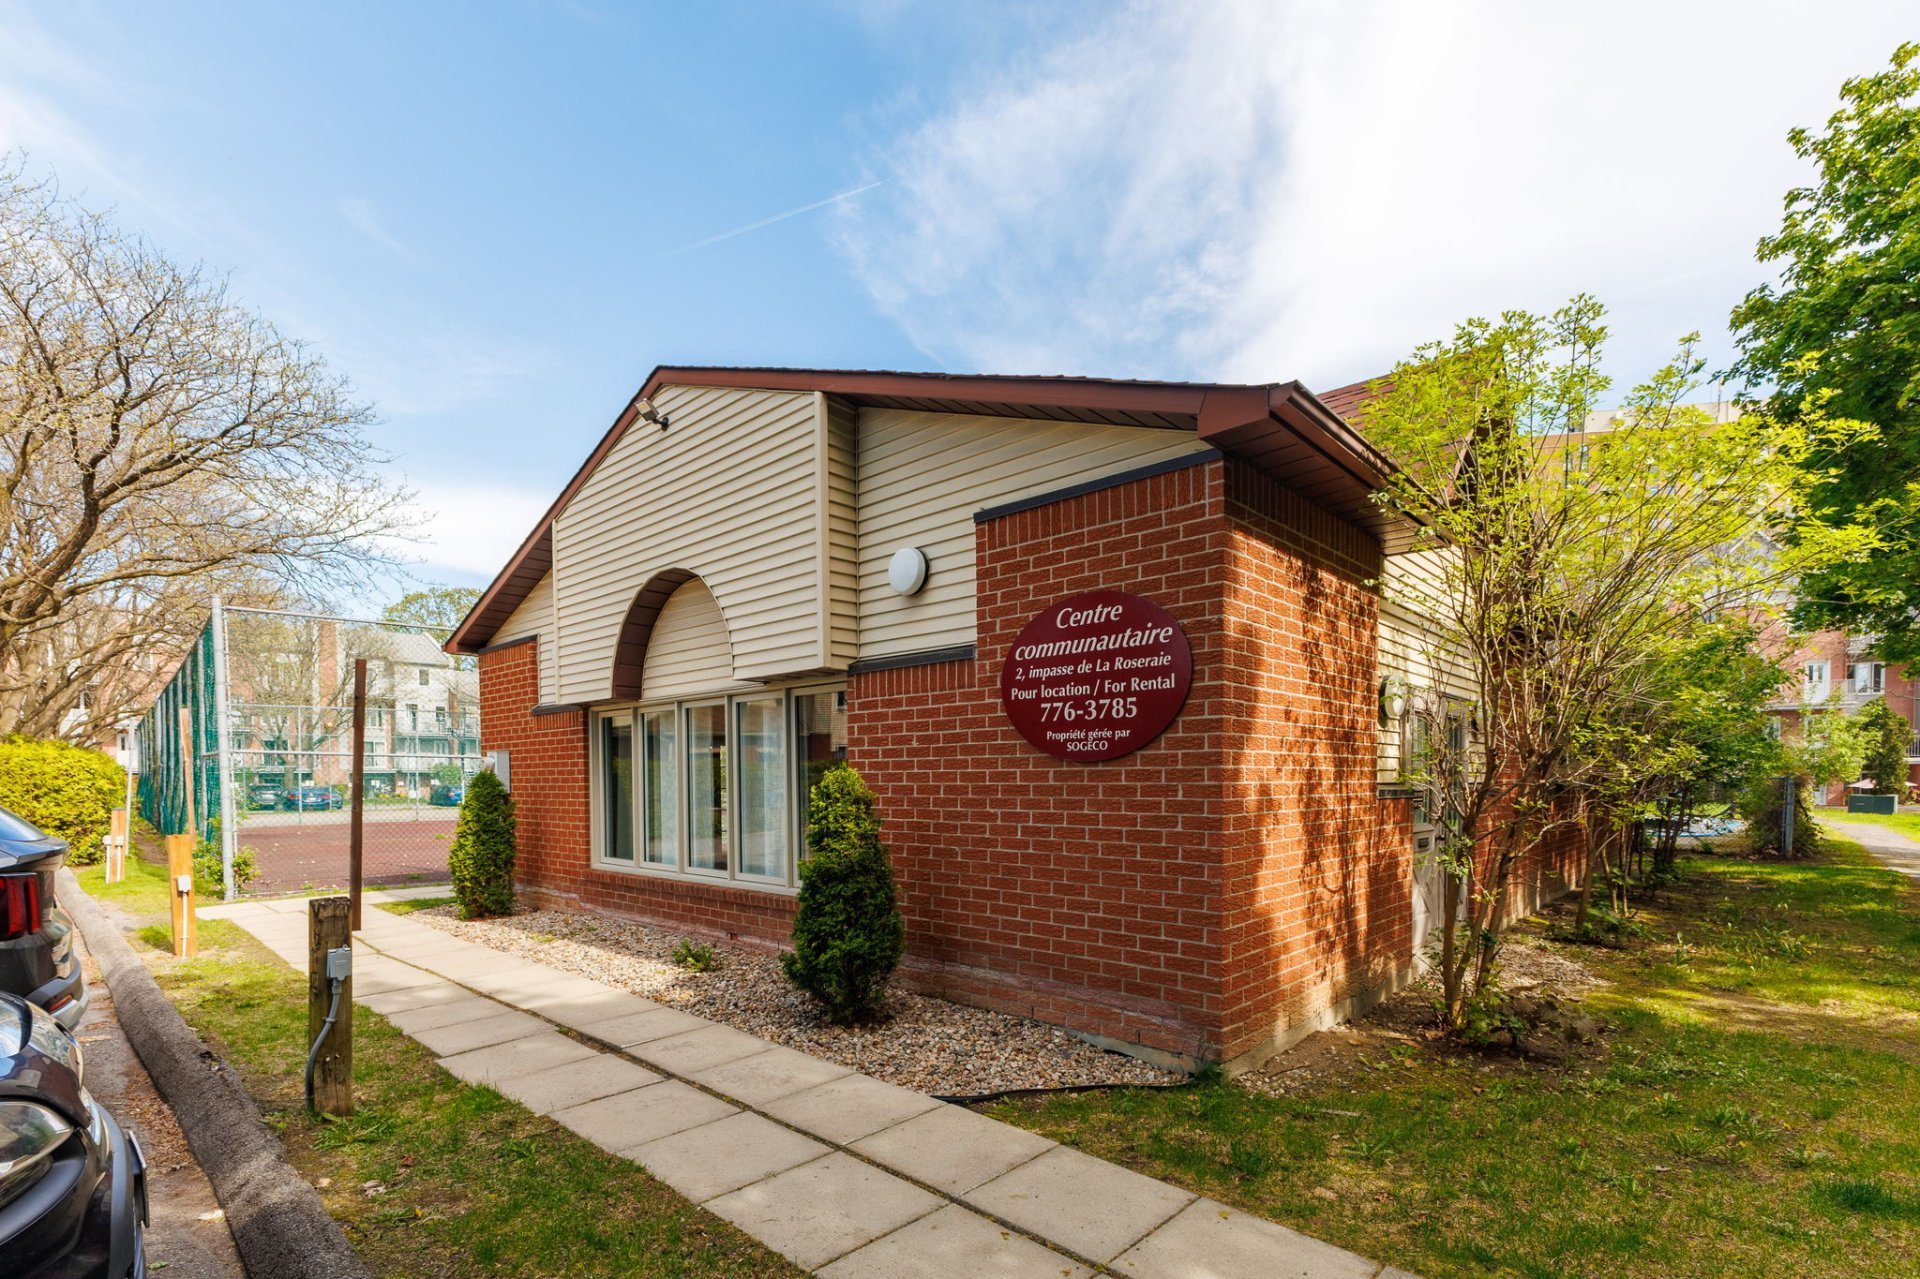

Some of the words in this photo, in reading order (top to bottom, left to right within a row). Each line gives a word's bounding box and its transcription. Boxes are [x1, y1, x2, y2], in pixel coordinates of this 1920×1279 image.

[1056, 604, 1122, 628] Centre
[1015, 623, 1173, 660] communautaire
[1029, 664, 1074, 680] impasse
[1077, 660, 1092, 673] de
[1096, 660, 1109, 671] La
[1115, 652, 1171, 670] Roseraie
[1011, 688, 1037, 700] Pour
[1041, 684, 1090, 698] location
[1105, 680, 1126, 693] For
[1131, 673, 1175, 689] Rental
[1041, 697, 1137, 722] 776-3785
[1047, 729, 1085, 741] Propriété
[1088, 728, 1112, 741] gérée
[1115, 729, 1130, 740] par
